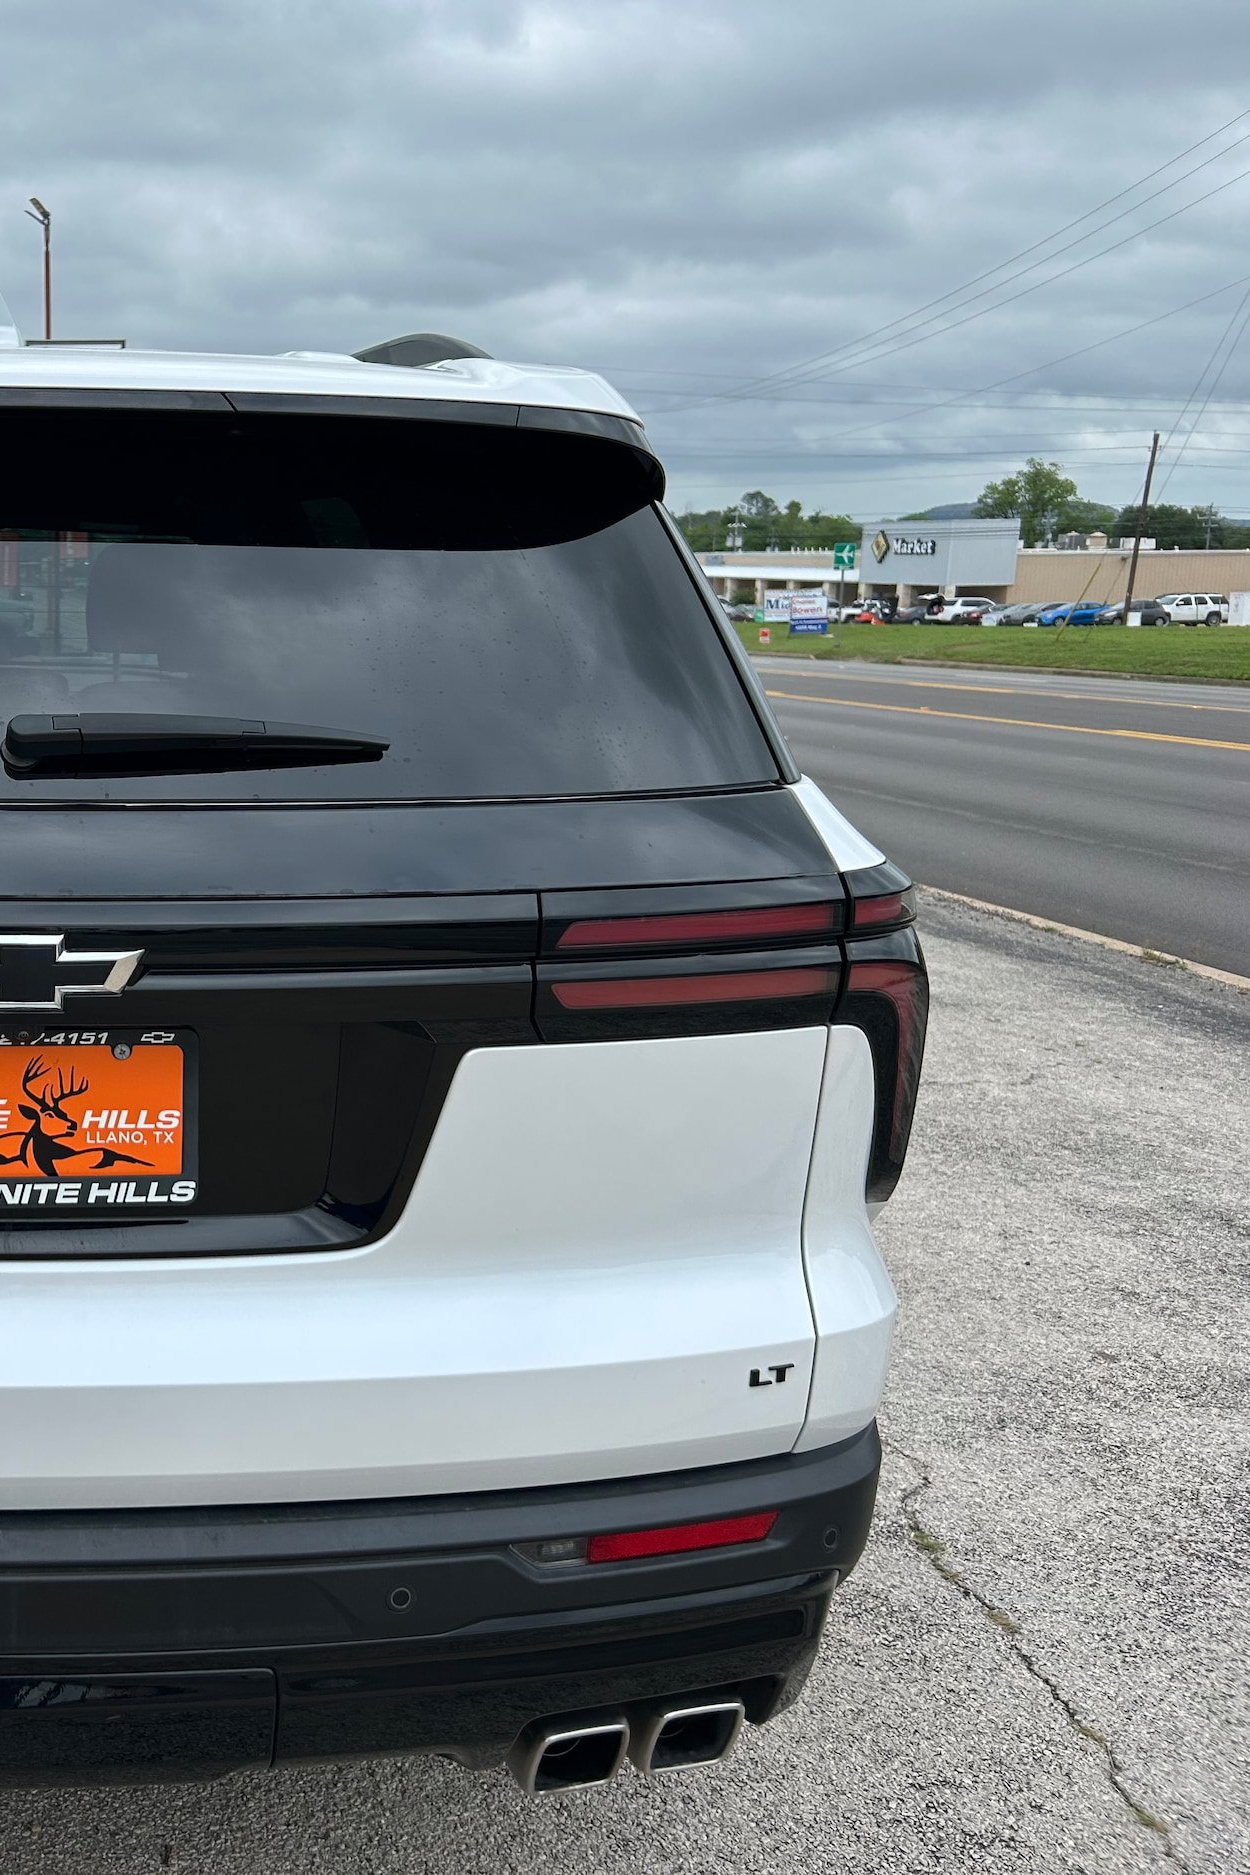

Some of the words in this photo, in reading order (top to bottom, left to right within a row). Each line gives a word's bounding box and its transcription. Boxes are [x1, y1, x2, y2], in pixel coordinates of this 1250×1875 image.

[893, 538, 936, 555] Market
[82, 1109, 180, 1129] HILLS
[86, 1131, 148, 1146] LLANO,
[153, 1131, 175, 1144] TX
[88, 1181, 197, 1204] HILLS
[749, 1363, 795, 1387] LT
